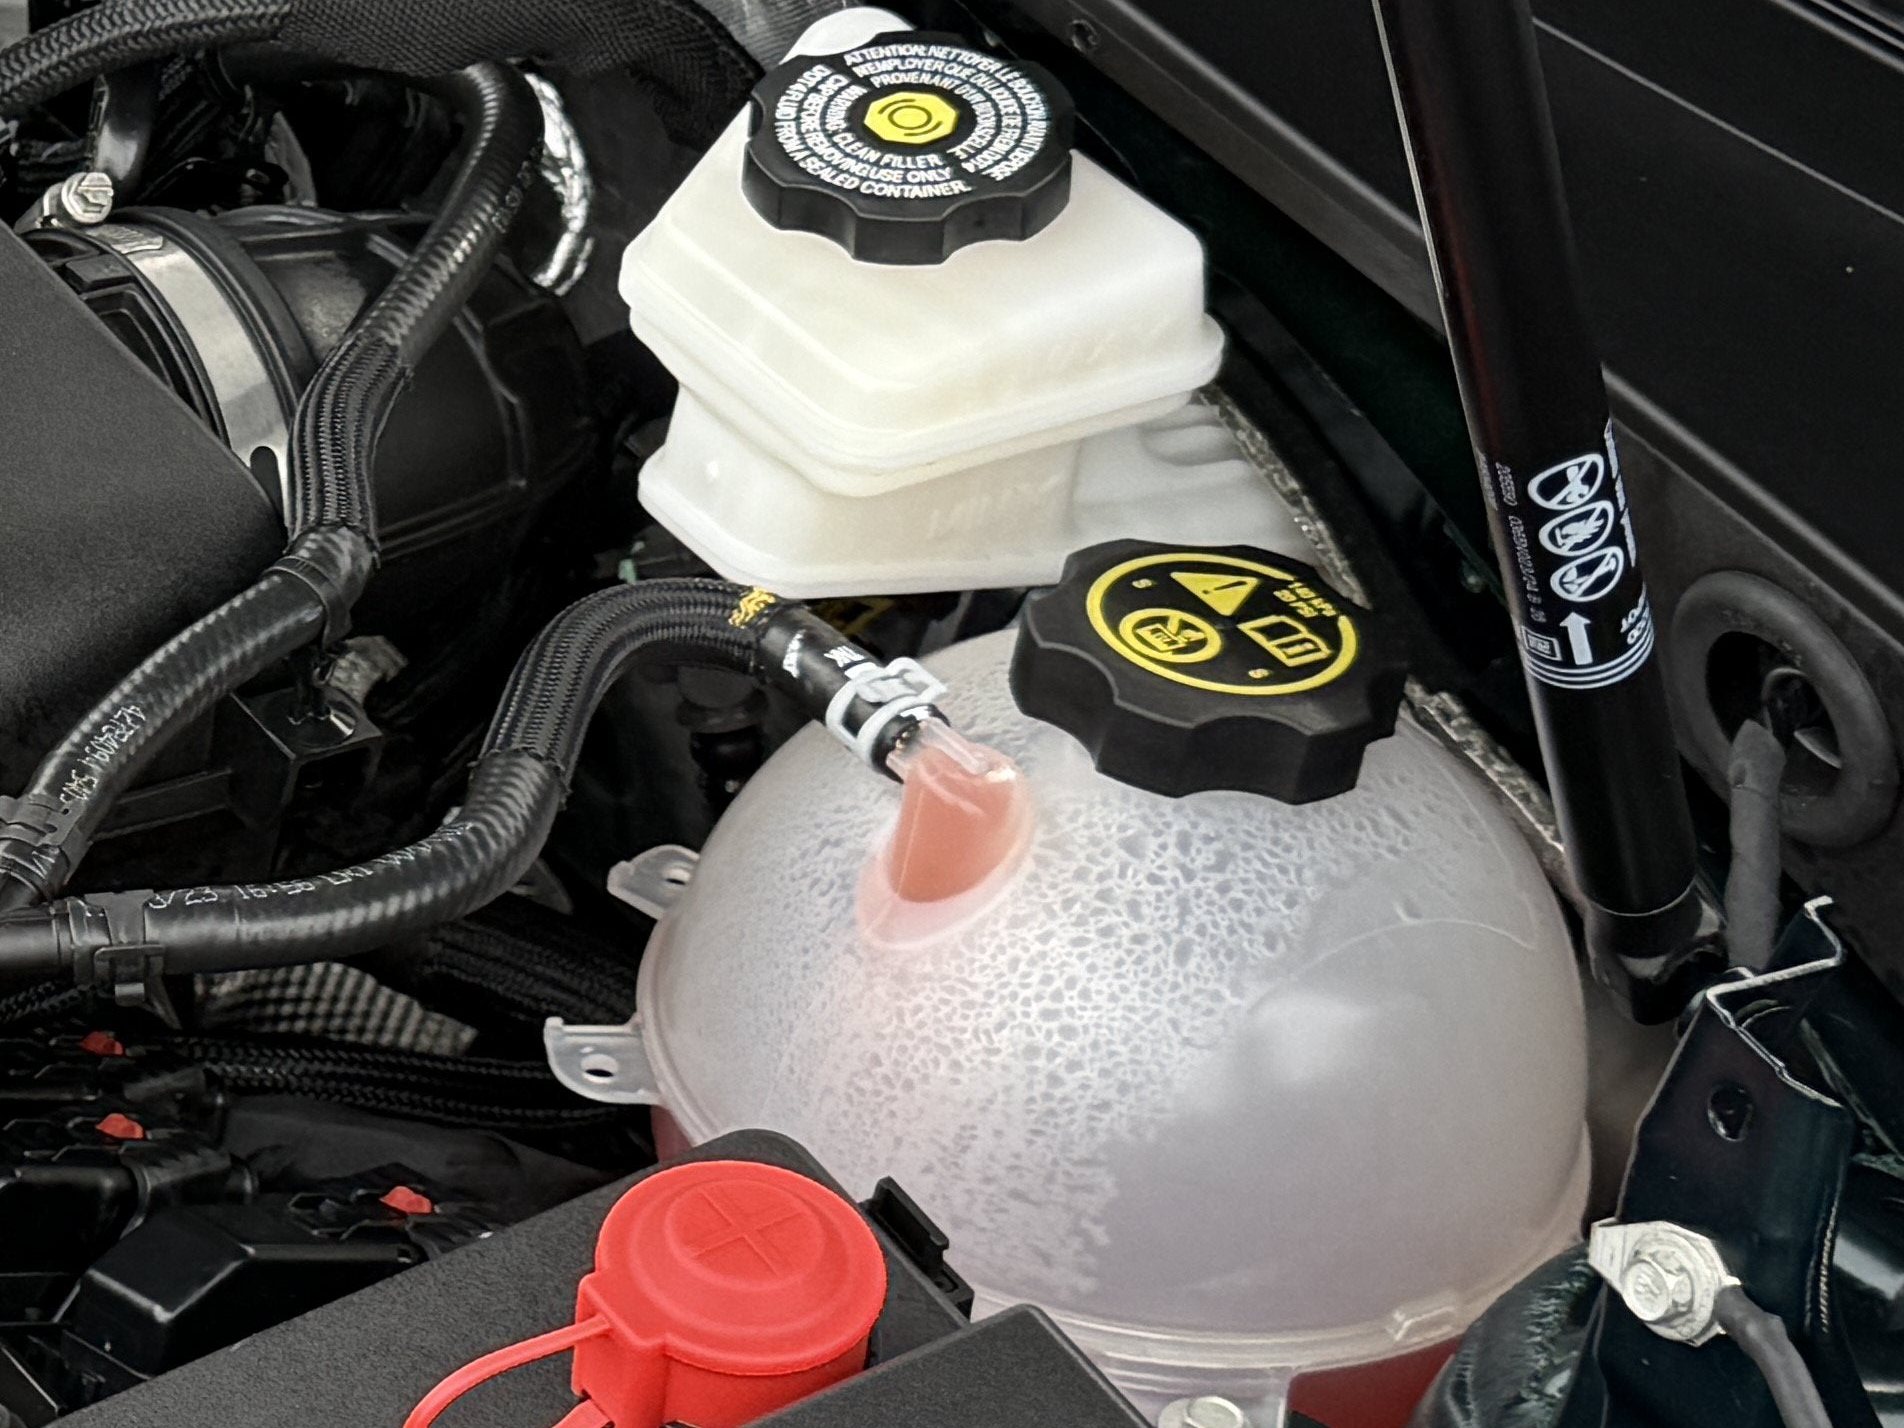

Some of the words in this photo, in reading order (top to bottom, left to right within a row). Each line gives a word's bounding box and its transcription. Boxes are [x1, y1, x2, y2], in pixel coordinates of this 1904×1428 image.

[928, 45, 1003, 73] NETTOYER
[797, 64, 834, 86] DOT
[817, 74, 850, 96] CAP
[870, 71, 962, 89] PROVENANT
[789, 83, 810, 93] 4
[775, 90, 804, 119] FLUID
[799, 93, 828, 133] BEFORE
[943, 62, 977, 80] QUE
[969, 150, 1002, 169] DOT
[774, 122, 806, 153] FROM
[789, 150, 811, 161] A
[832, 132, 882, 163] CLEAN
[879, 154, 944, 169] FILLER
[798, 156, 862, 189] SEALED
[866, 167, 904, 183] USE
[906, 167, 953, 183] ONLY
